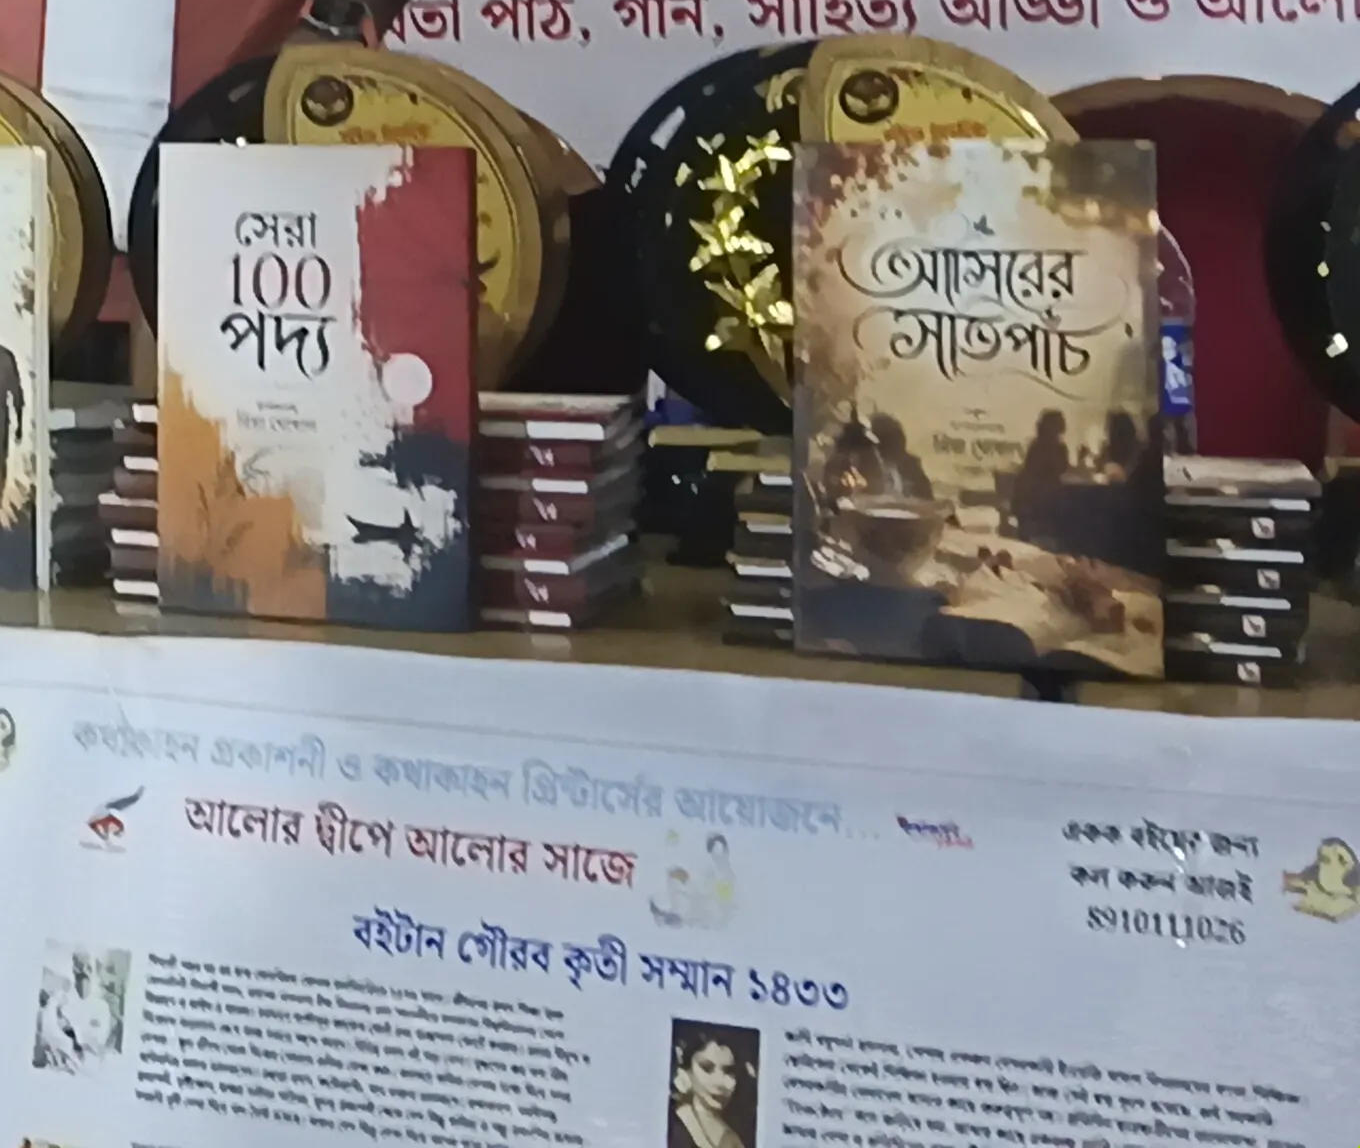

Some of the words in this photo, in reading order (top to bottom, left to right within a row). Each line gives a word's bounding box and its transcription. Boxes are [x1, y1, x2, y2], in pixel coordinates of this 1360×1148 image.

[234, 209, 318, 250] সেরা
[229, 251, 333, 310] 100
[839, 237, 1088, 309] আসরের
[220, 309, 337, 379] পদ্য
[336, 752, 363, 782] ও
[372, 753, 513, 802] কথাকাহন
[184, 796, 304, 847] আলোর
[314, 800, 397, 857] দ্বীপে
[404, 823, 531, 875] আলোর
[541, 841, 638, 889] সাজে
[353, 905, 447, 959] বইটান
[459, 919, 553, 976] গৌরব
[563, 933, 628, 991] কৃতী
[638, 950, 735, 999] সম্মান
[749, 967, 850, 1010] ১৪৩৩
